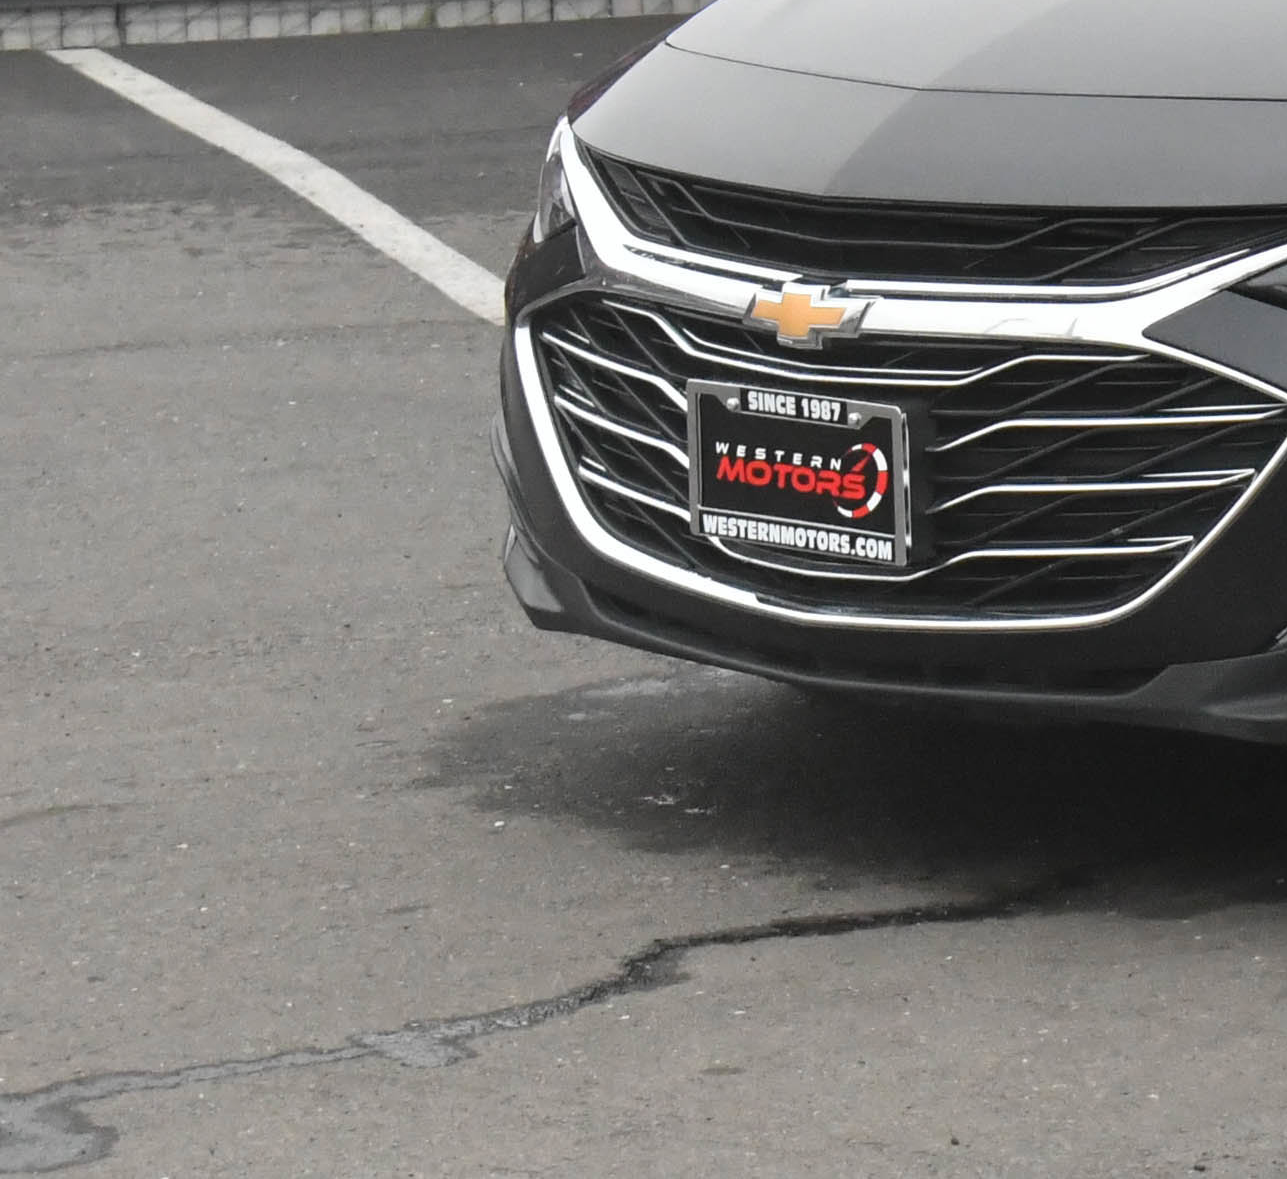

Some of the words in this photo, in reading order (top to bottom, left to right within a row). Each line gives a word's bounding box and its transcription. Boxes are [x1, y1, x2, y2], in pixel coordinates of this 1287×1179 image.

[748, 390, 797, 416] SINCE
[801, 398, 841, 422] 1987
[715, 441, 842, 471] WESTERN
[716, 455, 867, 500] MOTORS
[702, 513, 893, 562] WESTERNMOTORS.COM
